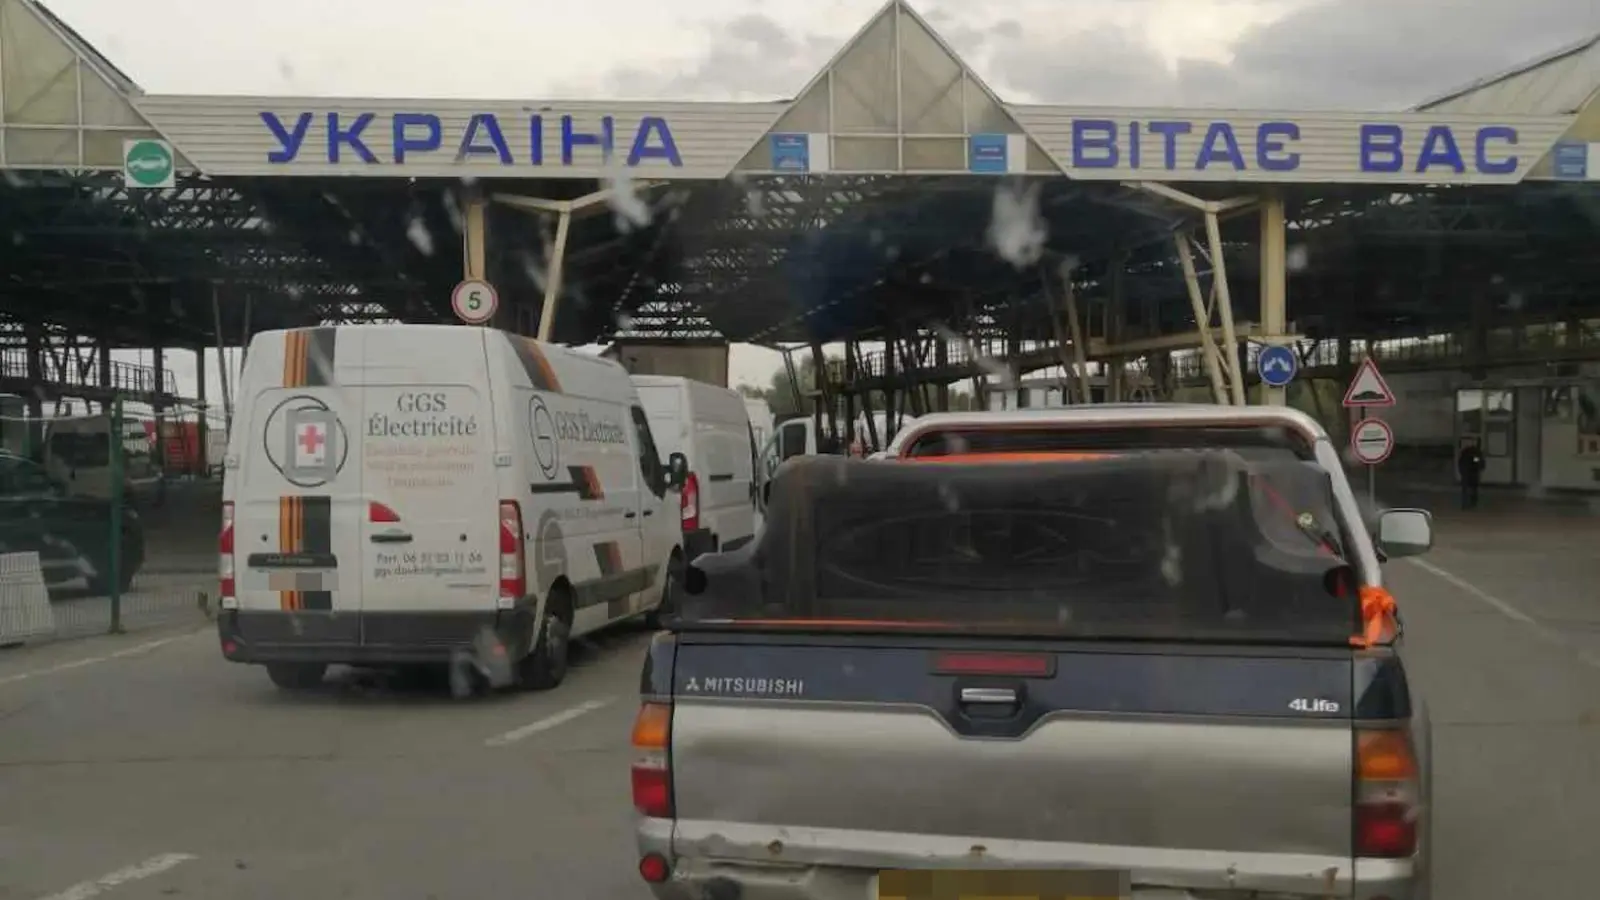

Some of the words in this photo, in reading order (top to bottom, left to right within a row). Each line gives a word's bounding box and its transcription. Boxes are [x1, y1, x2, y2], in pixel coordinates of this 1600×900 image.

[259, 107, 683, 167] УКРАЇНА
[1072, 119, 1300, 171] ВІТАЄ
[1360, 123, 1519, 174] ВАС
[468, 291, 481, 310] 5
[397, 392, 447, 412] GGS
[367, 412, 477, 436] Électricité
[704, 677, 804, 696] MITSUBISHI
[1287, 698, 1339, 713] 4Life
